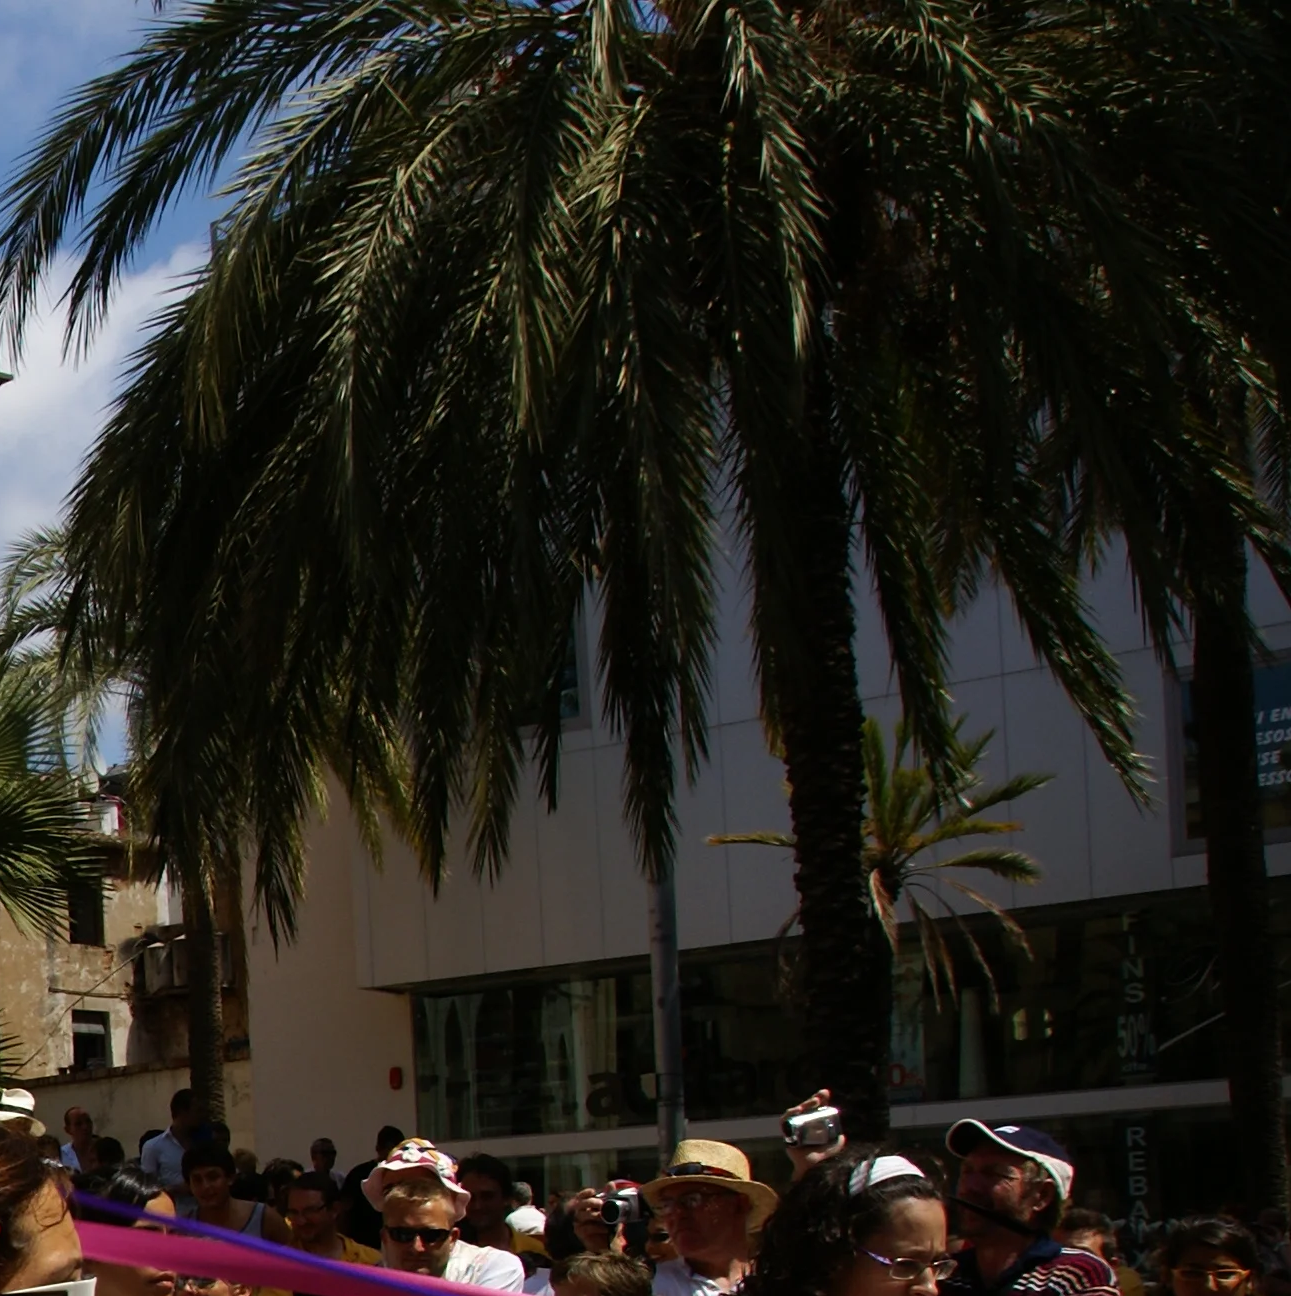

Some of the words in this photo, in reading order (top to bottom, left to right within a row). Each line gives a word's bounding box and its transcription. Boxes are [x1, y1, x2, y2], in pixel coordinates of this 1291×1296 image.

[1256, 728, 1291, 745] ESOS
[1257, 749, 1280, 766] SE
[1121, 911, 1146, 1005] FINS
[1117, 1014, 1158, 1061] 50%
[1126, 1126, 1153, 1268] REBAIX
